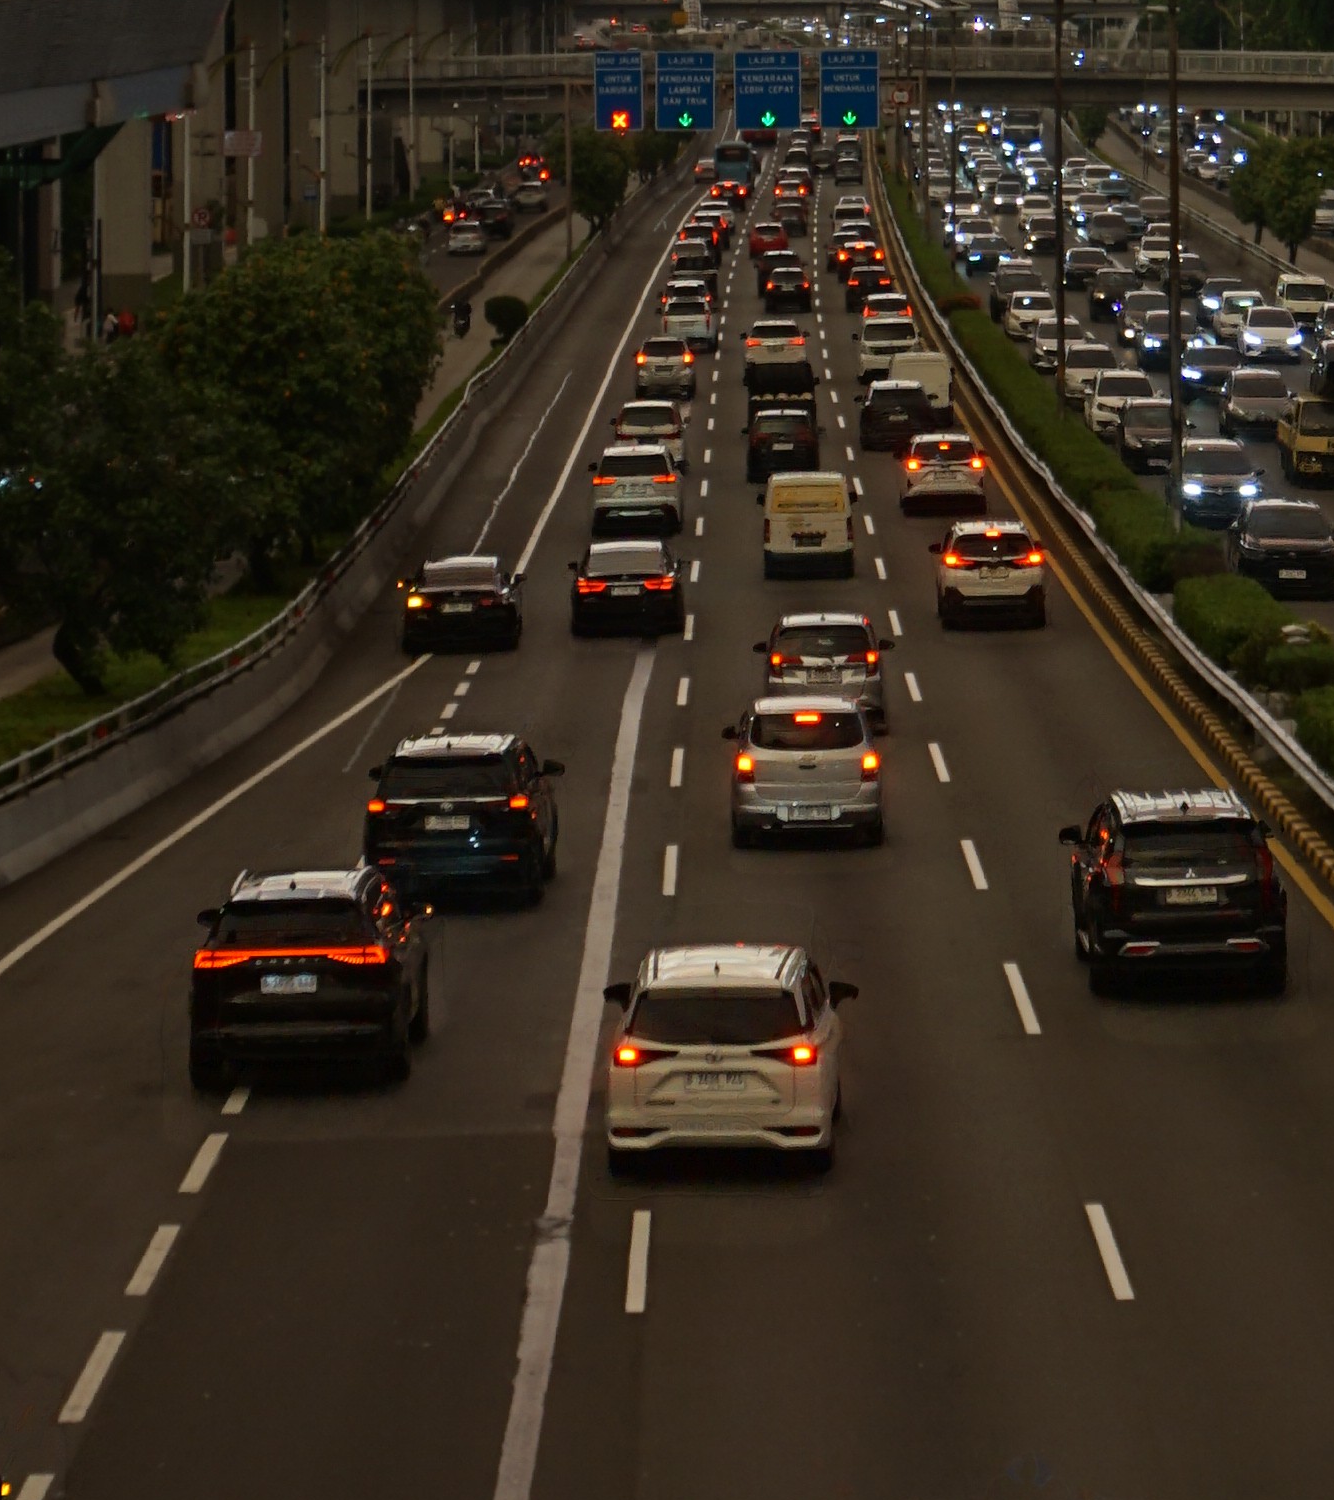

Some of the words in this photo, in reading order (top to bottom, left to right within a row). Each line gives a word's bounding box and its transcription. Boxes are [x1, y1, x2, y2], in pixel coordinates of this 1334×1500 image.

[668, 57, 694, 65] LAJUR
[748, 56, 775, 64] LAJUR
[827, 55, 855, 64] LAJUR
[603, 75, 632, 83] UNTUK
[659, 75, 711, 83] KENDARAAN
[741, 74, 794, 83] KENDARAAN
[833, 74, 860, 82] UNTUK
[669, 86, 701, 94] LAMBAT
[739, 85, 764, 93] LEBIH
[768, 85, 795, 93] CEPAT
[686, 97, 708, 105] TRUK
